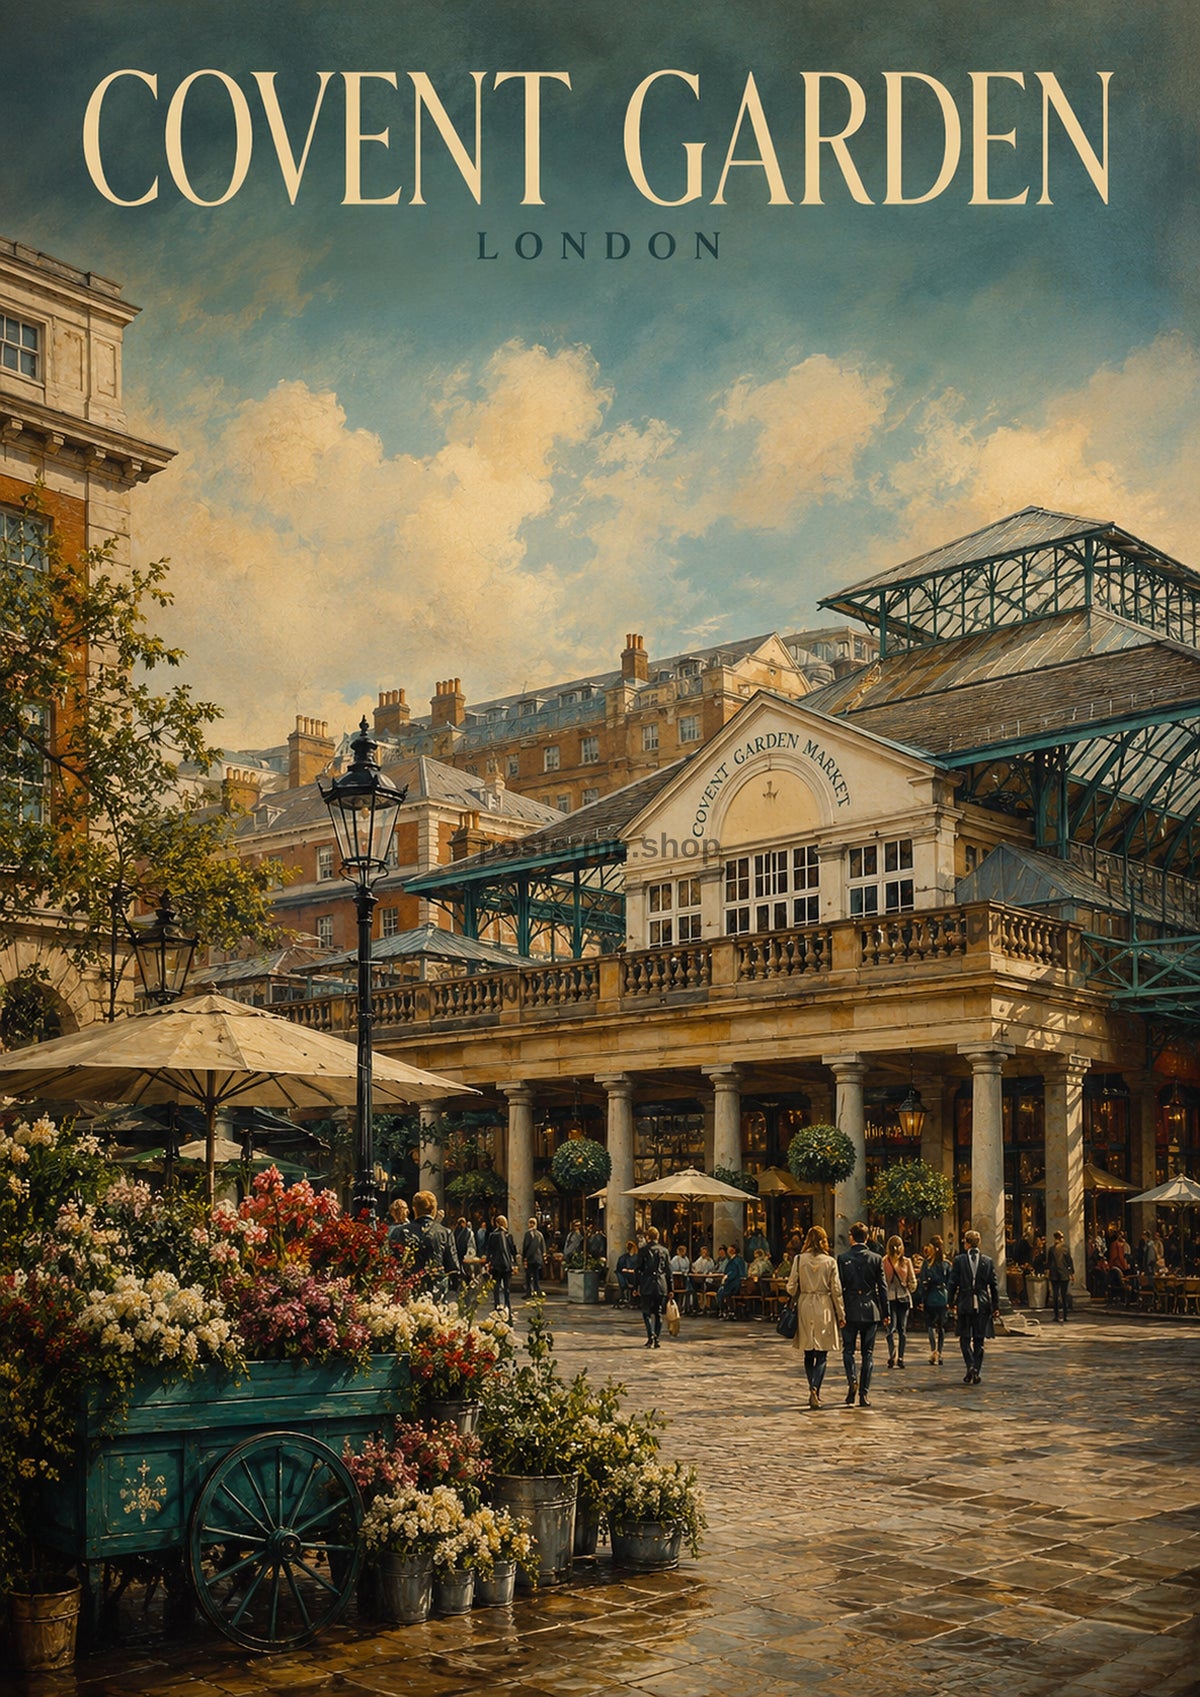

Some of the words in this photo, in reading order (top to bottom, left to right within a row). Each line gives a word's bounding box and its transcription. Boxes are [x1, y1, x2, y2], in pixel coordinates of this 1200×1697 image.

[83, 69, 572, 207] COVENT
[623, 69, 1114, 207] GARDEN
[477, 231, 721, 260] LONDON
[692, 761, 730, 838] COVENT
[732, 731, 800, 766] GARDEN
[802, 738, 852, 808] MARKET
